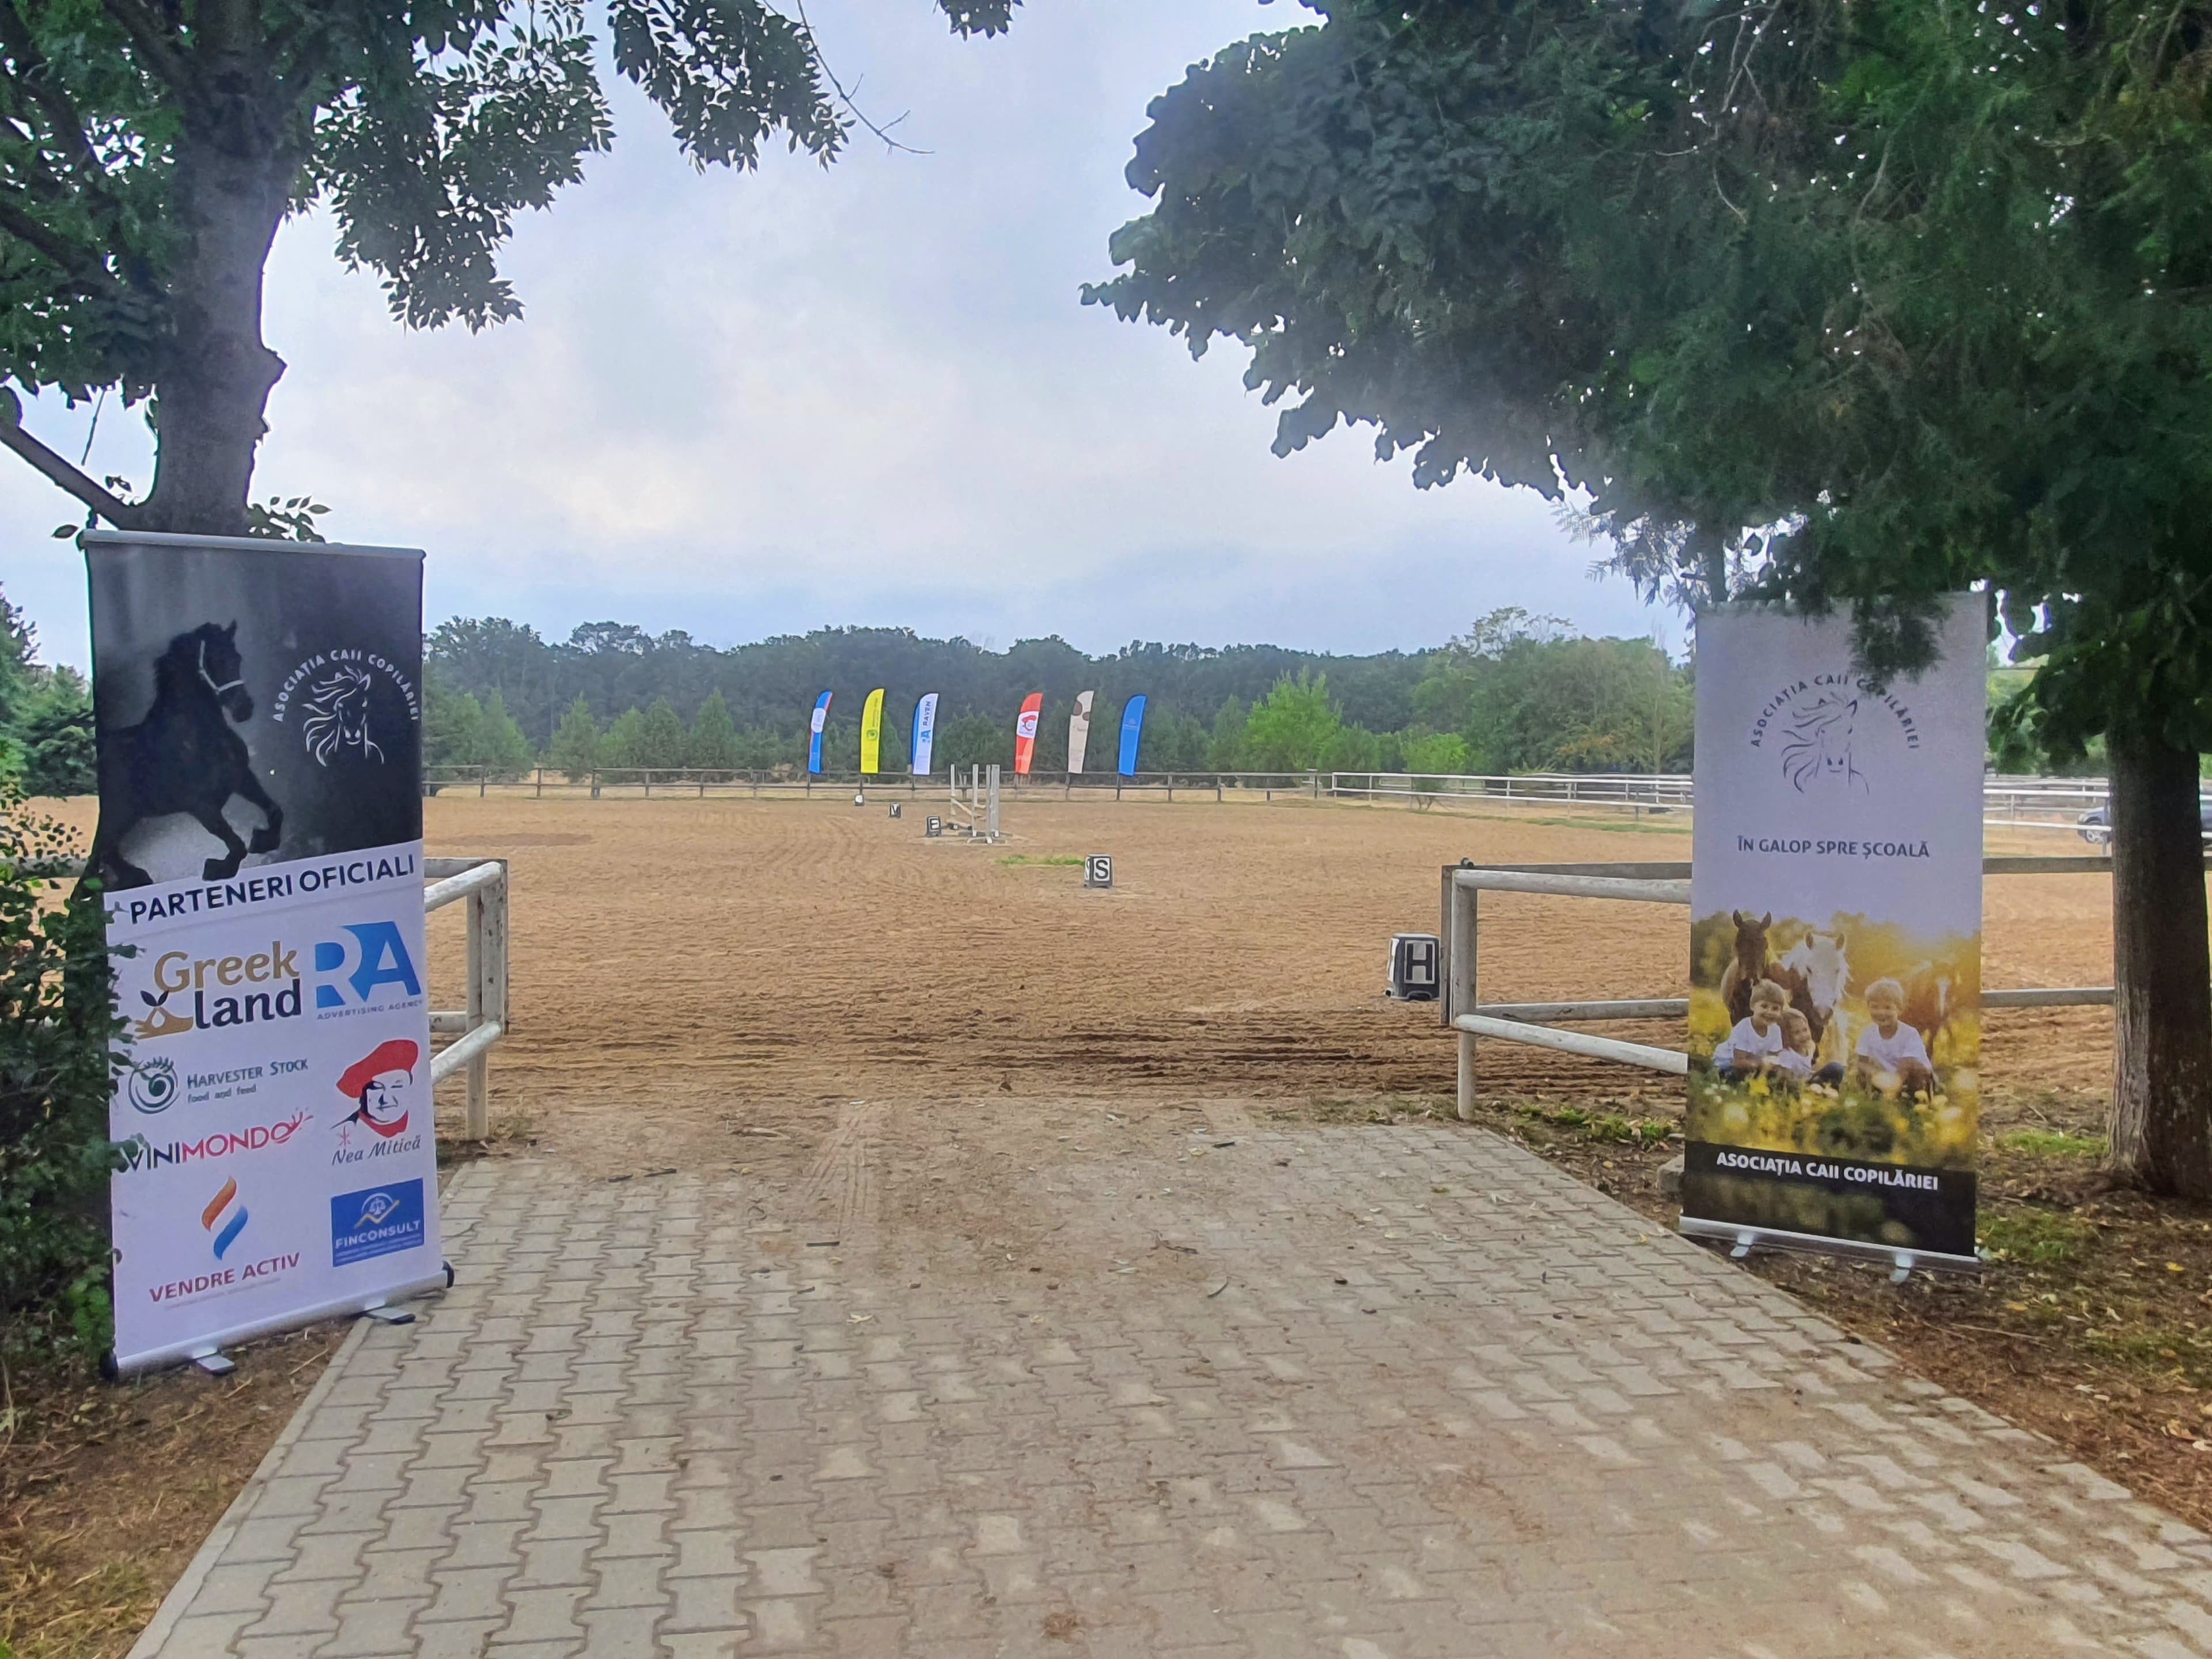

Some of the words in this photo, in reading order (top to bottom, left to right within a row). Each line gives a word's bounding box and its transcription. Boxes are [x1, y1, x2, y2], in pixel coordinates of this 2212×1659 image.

[330, 649, 362, 661] CAII
[1814, 673, 1849, 685] CAII
[930, 818, 940, 830] E
[1759, 839, 1812, 854] GALOP
[1816, 840, 1858, 855] SPRE
[1095, 859, 1109, 880] S
[130, 876, 292, 925] PARTENERI
[299, 854, 414, 892] OFICIALI
[154, 941, 300, 993] Greek
[314, 921, 422, 1009] RA
[1406, 942, 1433, 981] H
[194, 978, 302, 1029] land
[332, 1149, 364, 1166] Nea
[1806, 1162, 1839, 1179] CAII
[335, 1219, 421, 1249] FINCONSULT
[149, 1268, 235, 1302] VENDRE
[241, 1252, 300, 1280] ACTIV
